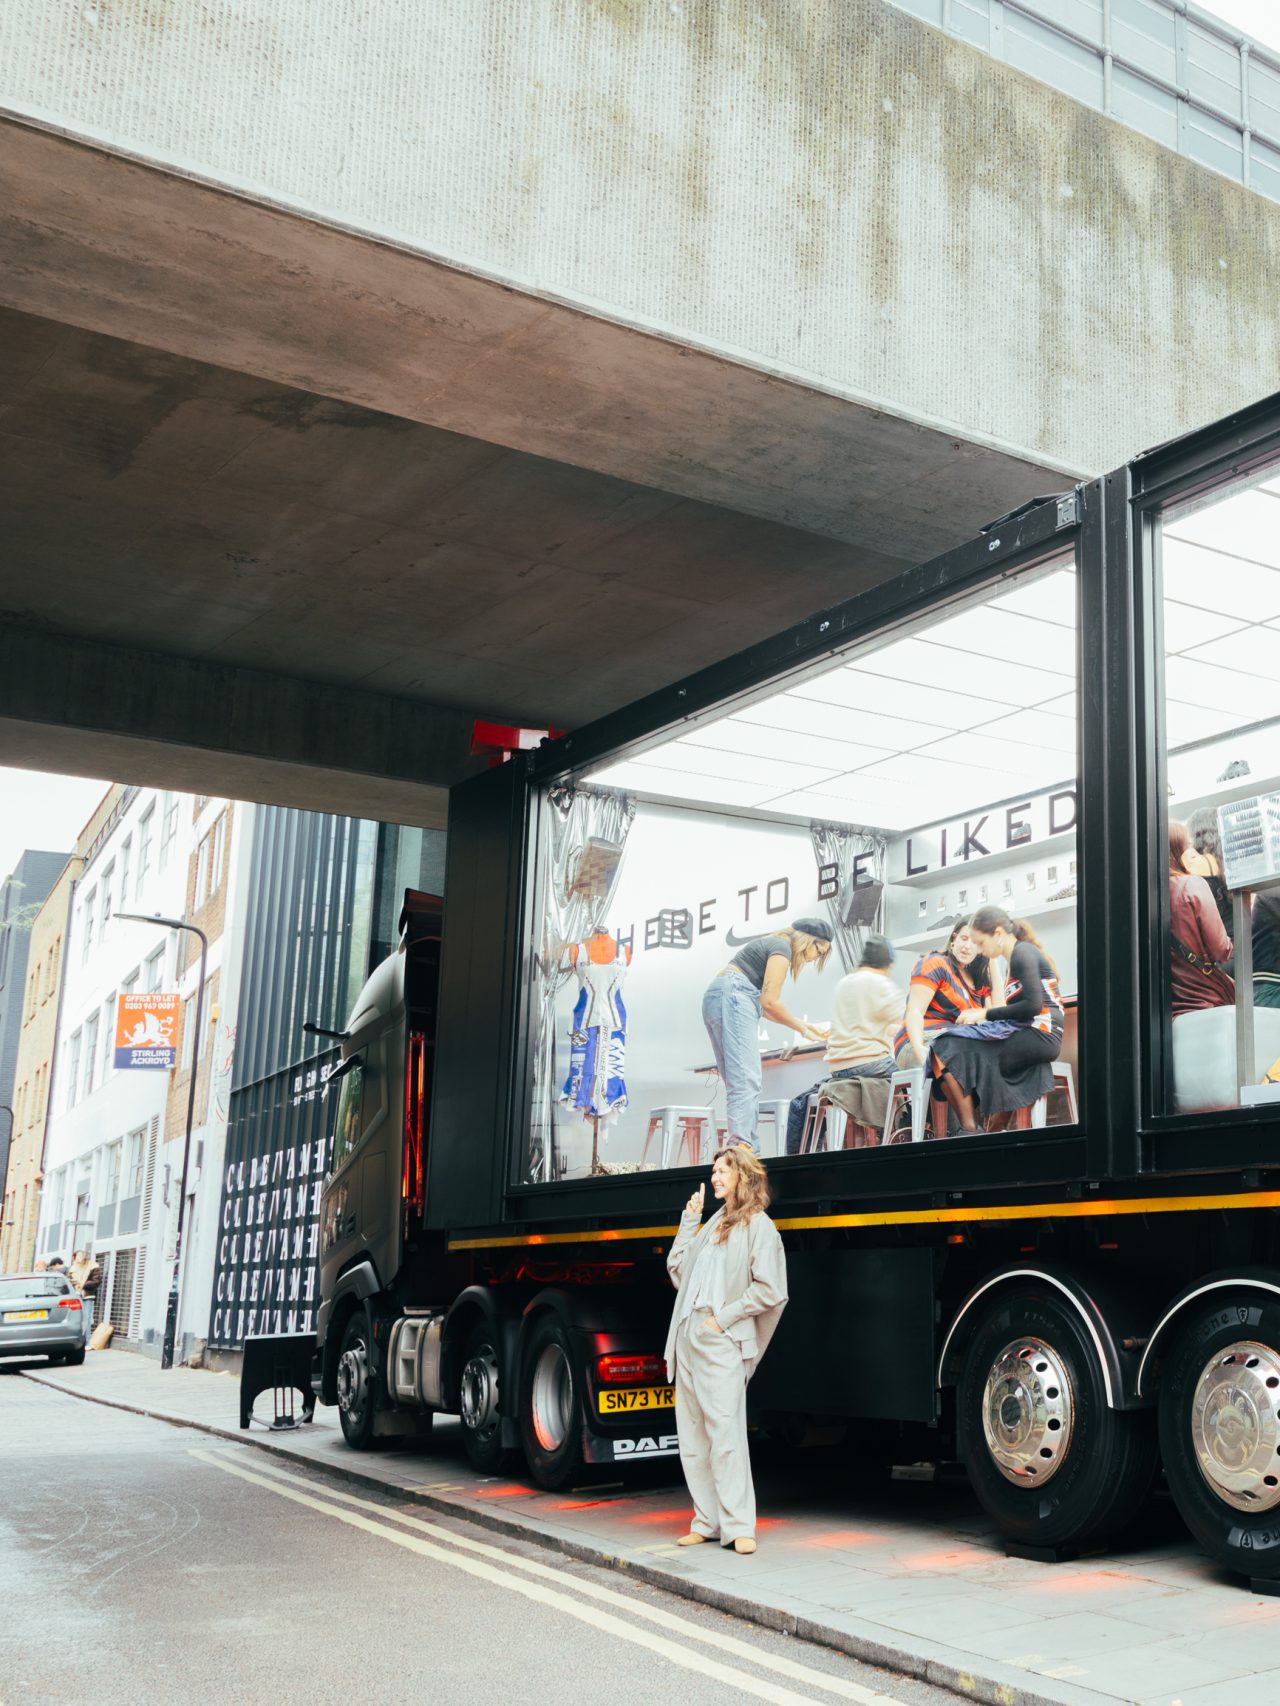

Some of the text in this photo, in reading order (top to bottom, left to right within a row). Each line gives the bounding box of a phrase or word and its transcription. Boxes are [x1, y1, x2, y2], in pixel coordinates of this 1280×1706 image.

[616, 898, 717, 958] HERE
[738, 876, 789, 922] TO
[817, 850, 875, 902] BE
[906, 789, 1077, 876] LIKED
[606, 1388, 676, 1410] SN73 YR
[613, 1434, 679, 1454] DAF
